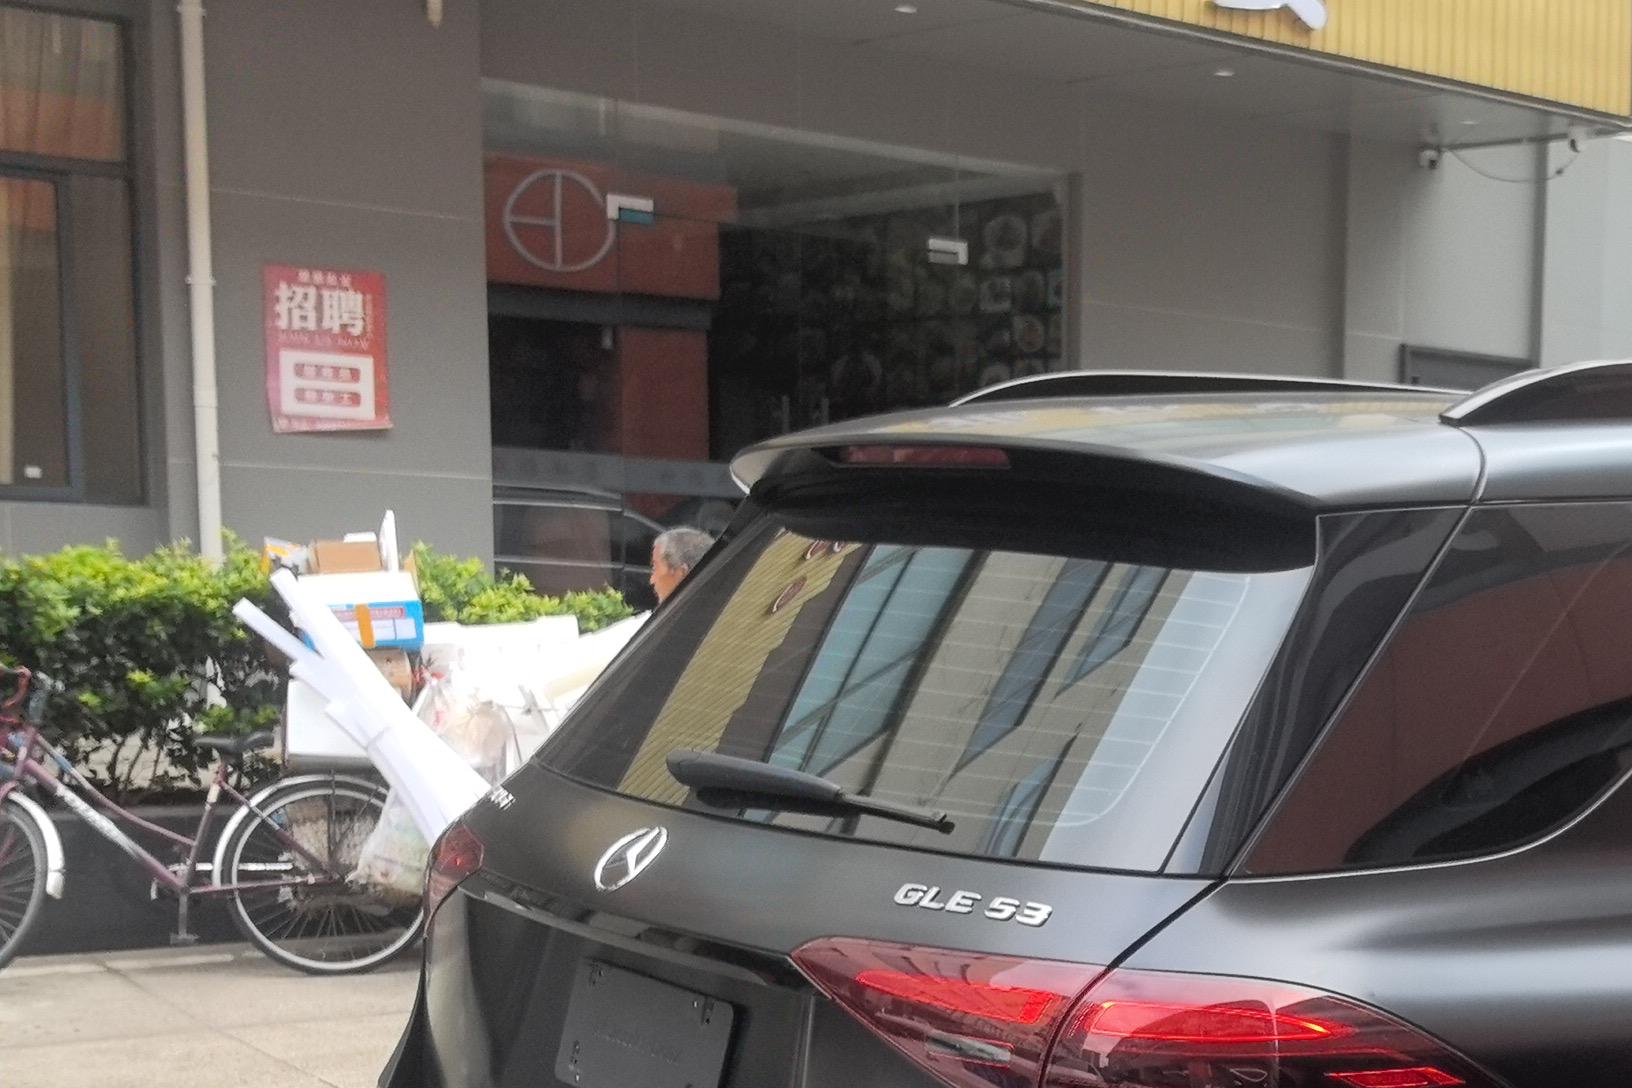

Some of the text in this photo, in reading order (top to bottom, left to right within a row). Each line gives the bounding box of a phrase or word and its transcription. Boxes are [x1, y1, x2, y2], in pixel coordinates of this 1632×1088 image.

[273, 282, 364, 337] 招聘
[894, 882, 1053, 928] GLE 53
